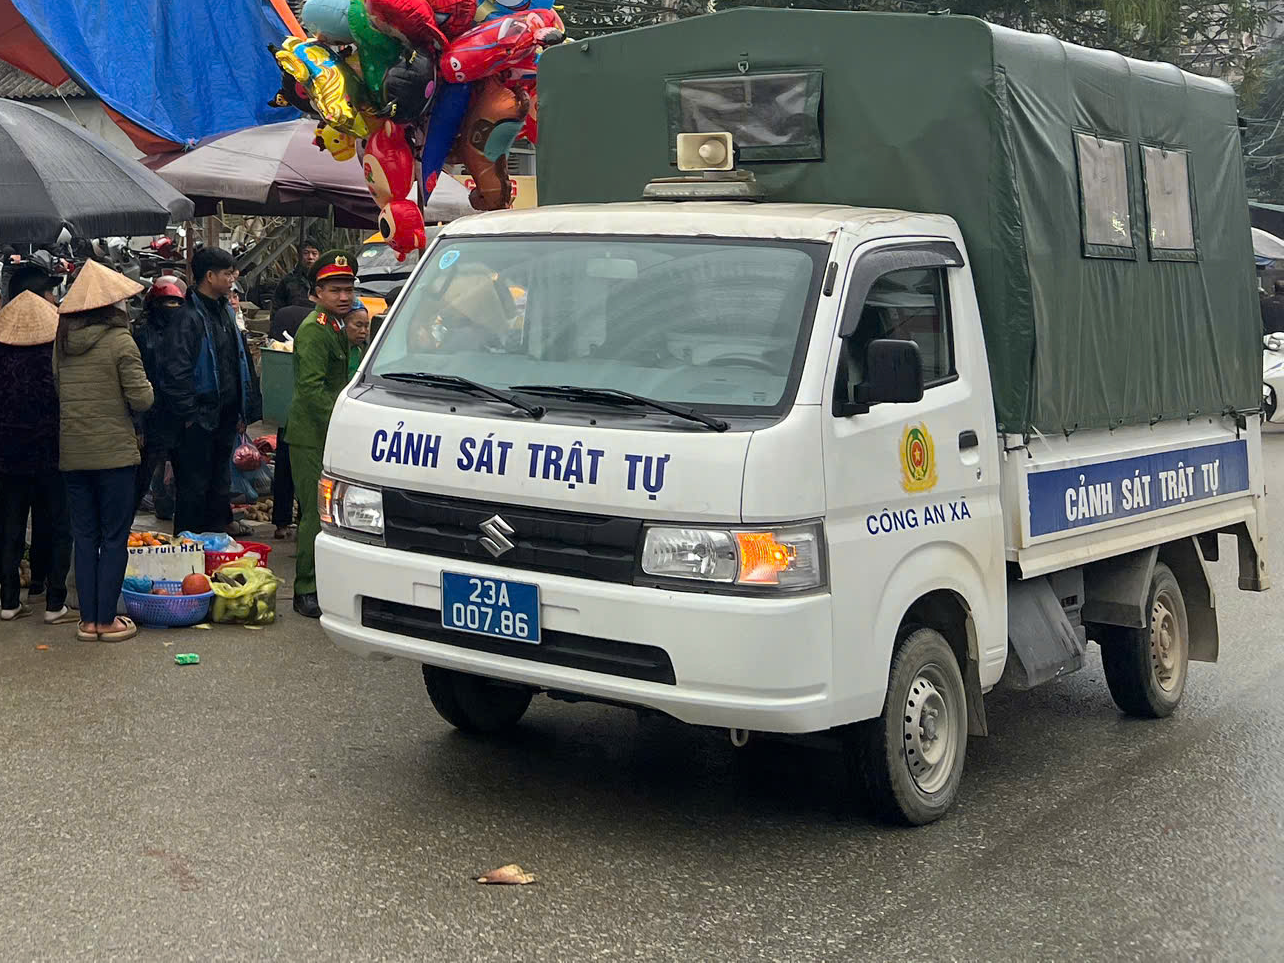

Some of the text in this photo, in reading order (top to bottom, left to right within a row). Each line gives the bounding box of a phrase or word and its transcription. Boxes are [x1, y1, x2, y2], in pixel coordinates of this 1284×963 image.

[370, 420, 671, 501] CẢNH SÁT TRẬT TỰ
[1065, 458, 1220, 522] CẢNH SÁT TRẬT TỰ
[866, 496, 972, 535] CÔNG AN XÃ
[469, 578, 510, 608] 23A
[452, 602, 528, 638] 007.86
